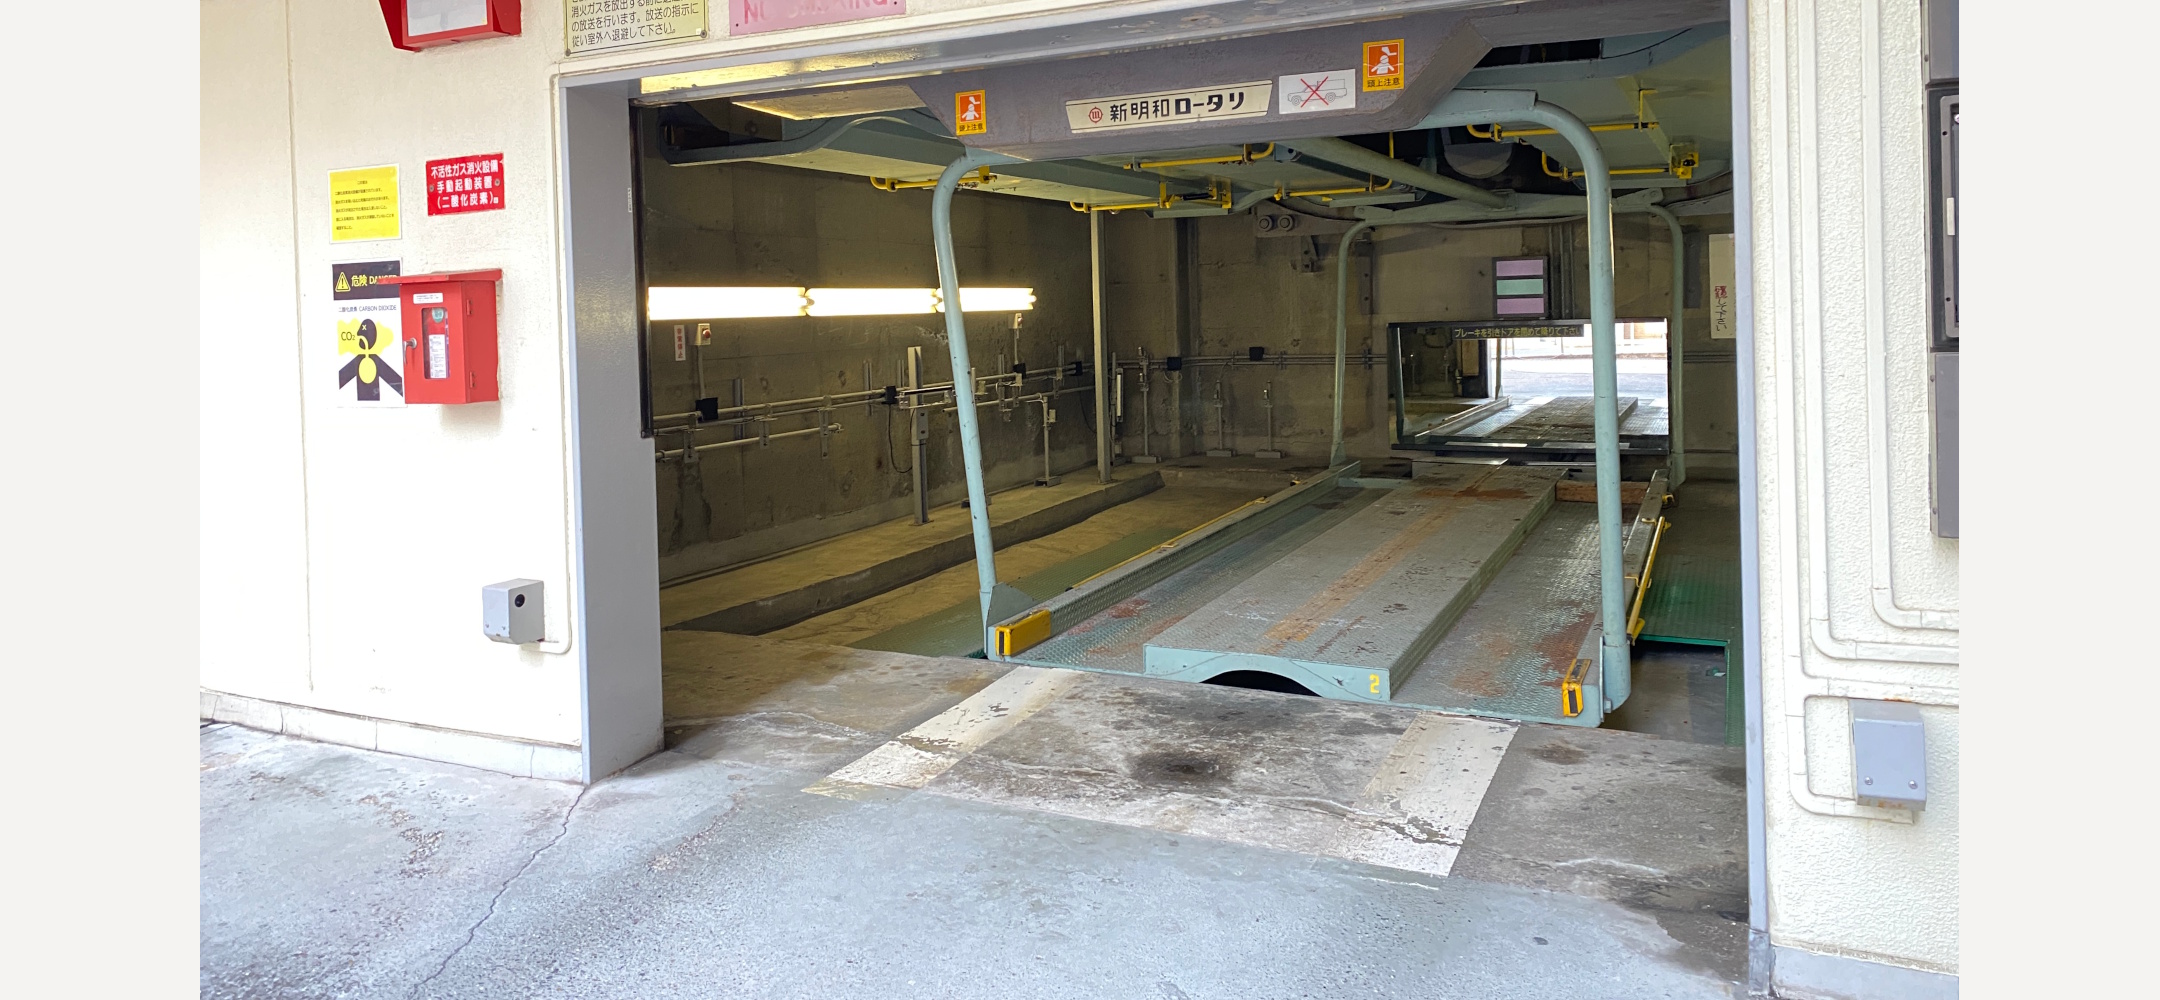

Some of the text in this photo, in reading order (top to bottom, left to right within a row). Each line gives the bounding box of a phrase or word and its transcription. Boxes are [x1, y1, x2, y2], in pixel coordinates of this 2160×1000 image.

[571, 3, 699, 32] の放送を行います。放送の指示に
[1109, 91, 1245, 123] 新明和ロータリ
[430, 159, 499, 179] 不活性ガス消火設備
[437, 175, 493, 194] 手動起動装置
[351, 274, 368, 287] 危険
[1369, 673, 1380, 694] 2
